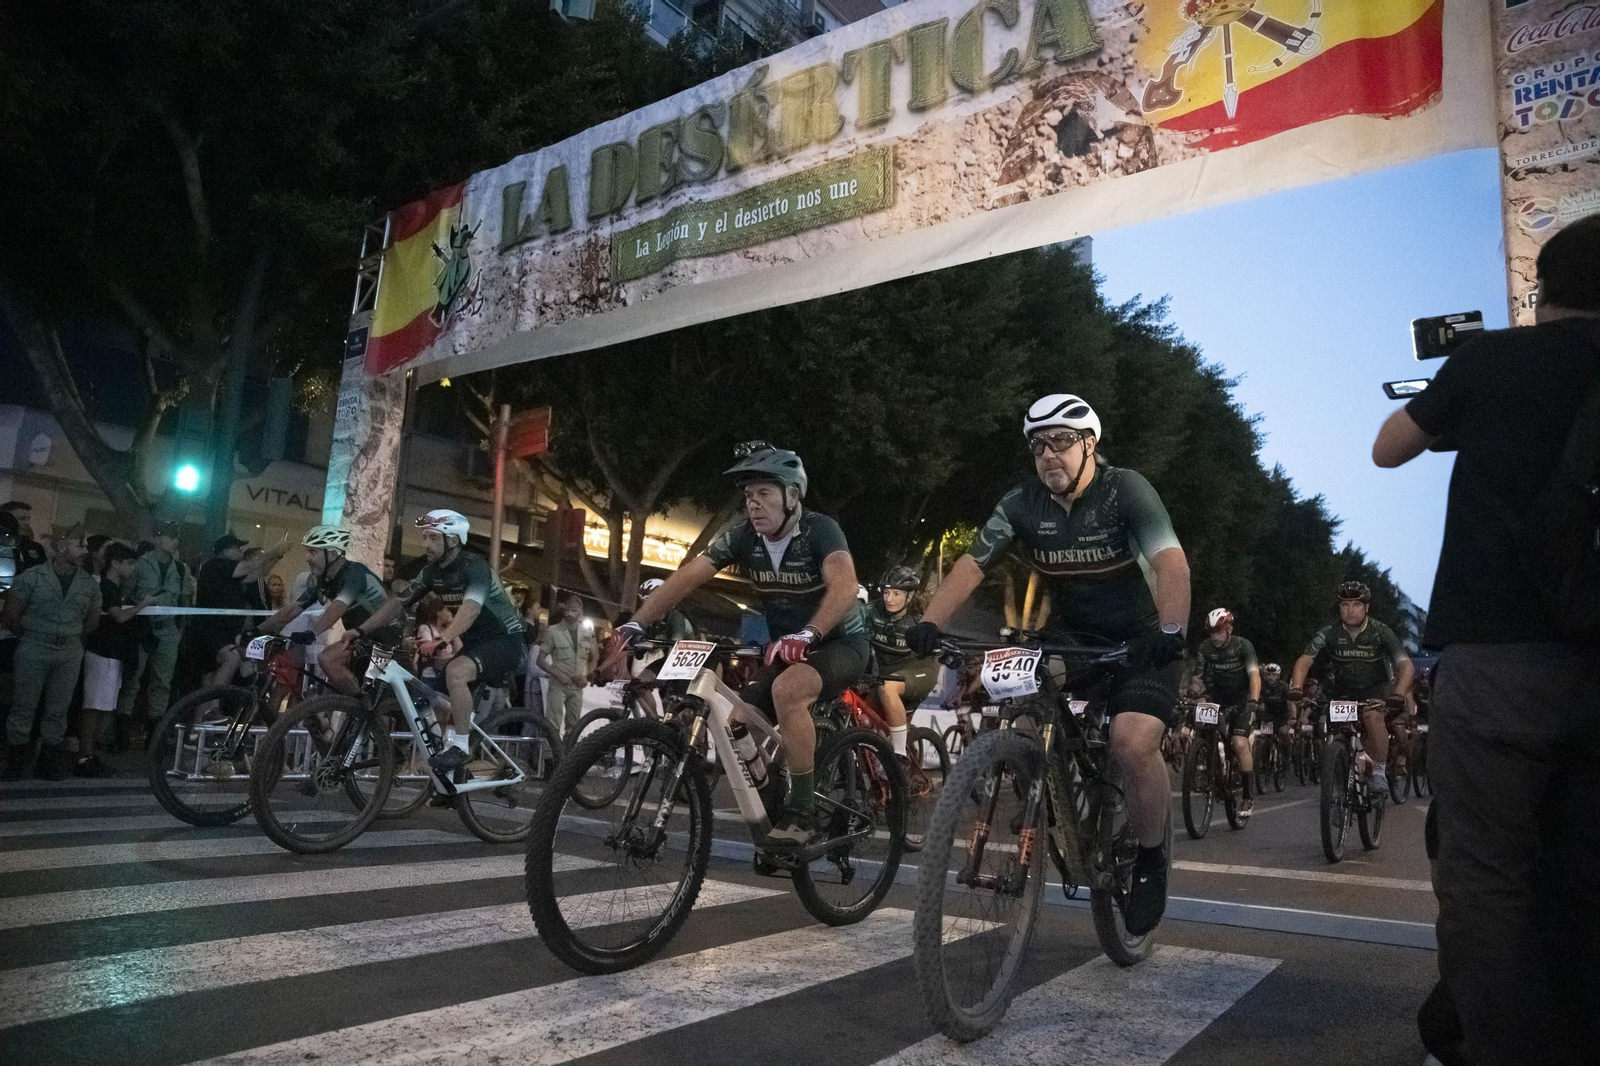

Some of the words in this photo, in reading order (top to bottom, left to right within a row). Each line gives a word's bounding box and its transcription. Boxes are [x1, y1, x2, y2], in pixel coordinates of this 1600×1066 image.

[500, 180, 572, 255] LA
[588, 0, 1105, 220] DESÉRTICA
[635, 238, 649, 259] La
[655, 221, 689, 252] Legión
[697, 220, 708, 241] y
[715, 212, 728, 234] el
[734, 198, 789, 229] desierto
[796, 188, 821, 210] nos
[829, 178, 858, 199] une
[246, 484, 321, 512] VITAL
[1048, 545, 1116, 564] DESÉRTICA
[672, 651, 707, 667] 5620
[991, 657, 1036, 683] 5540
[1335, 705, 1356, 714] 5218
